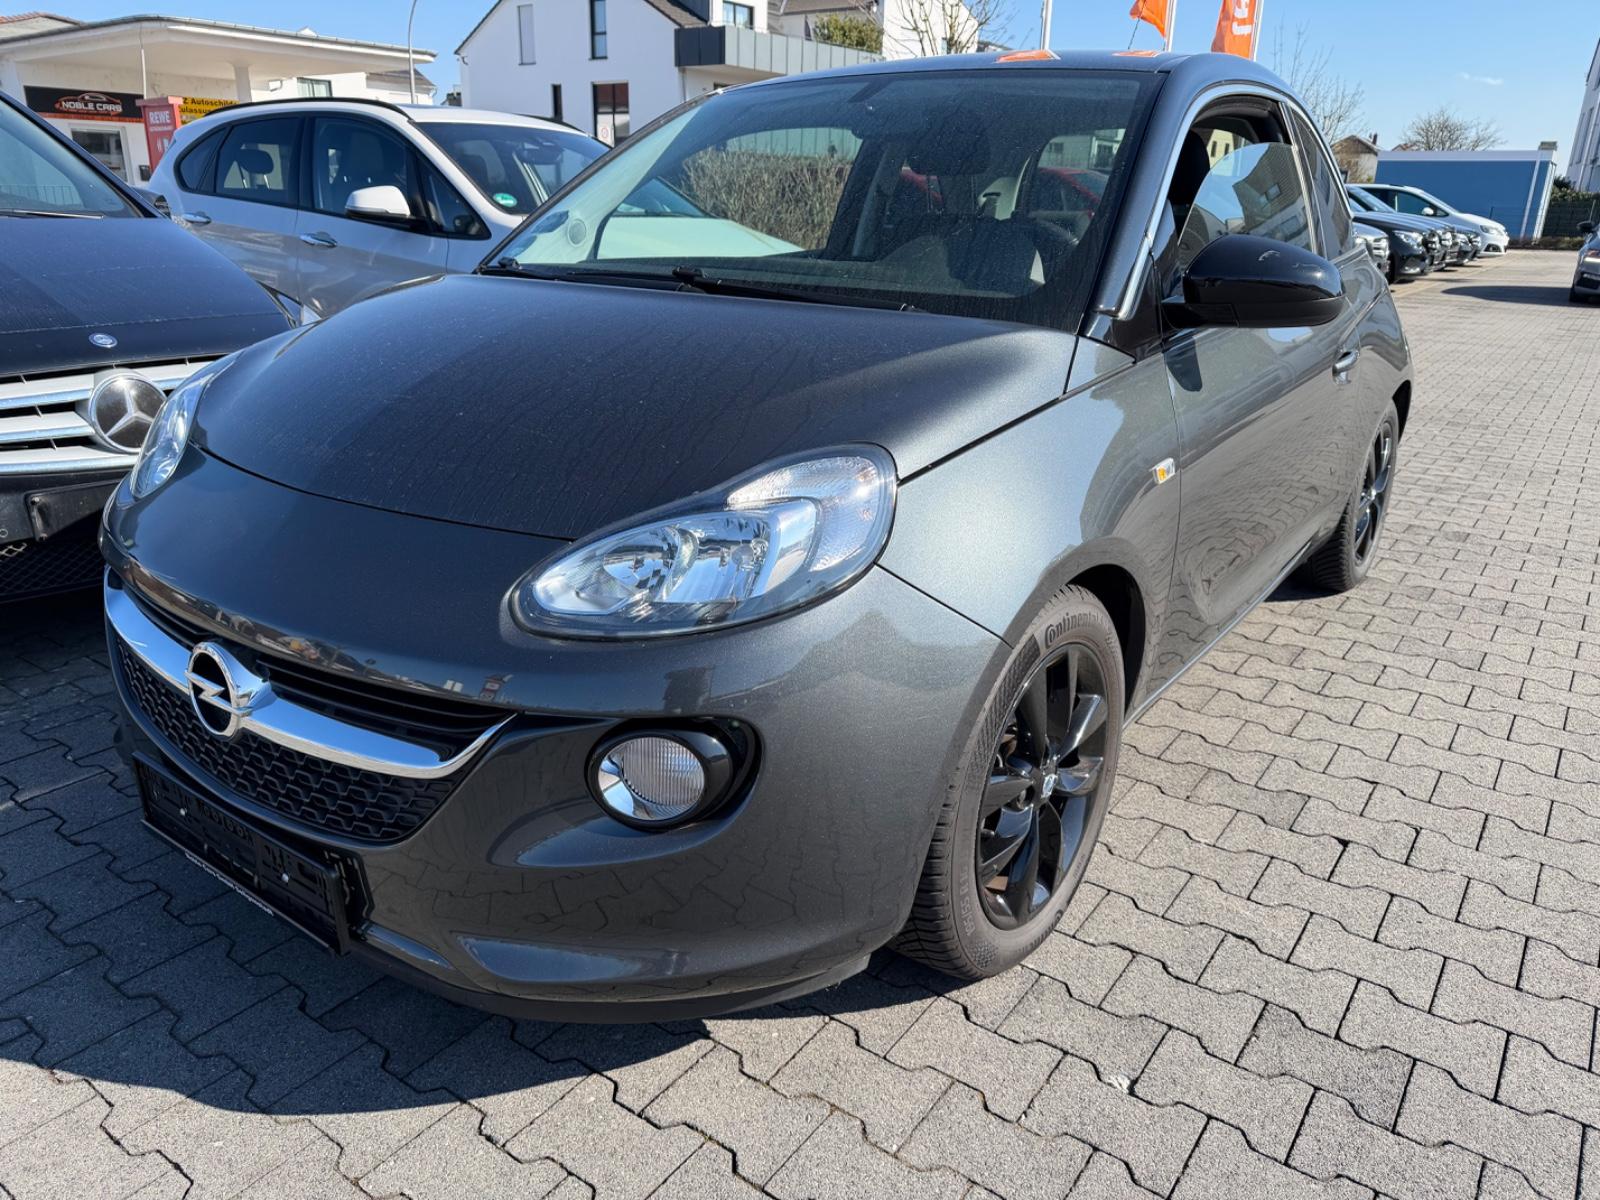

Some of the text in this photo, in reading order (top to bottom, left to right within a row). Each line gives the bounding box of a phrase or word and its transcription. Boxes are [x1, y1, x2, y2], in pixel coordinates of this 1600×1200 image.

[62, 101, 95, 110] NOBLE
[96, 103, 122, 112] CARS
[149, 110, 171, 124] REWE
[1045, 612, 1100, 649] Continental
